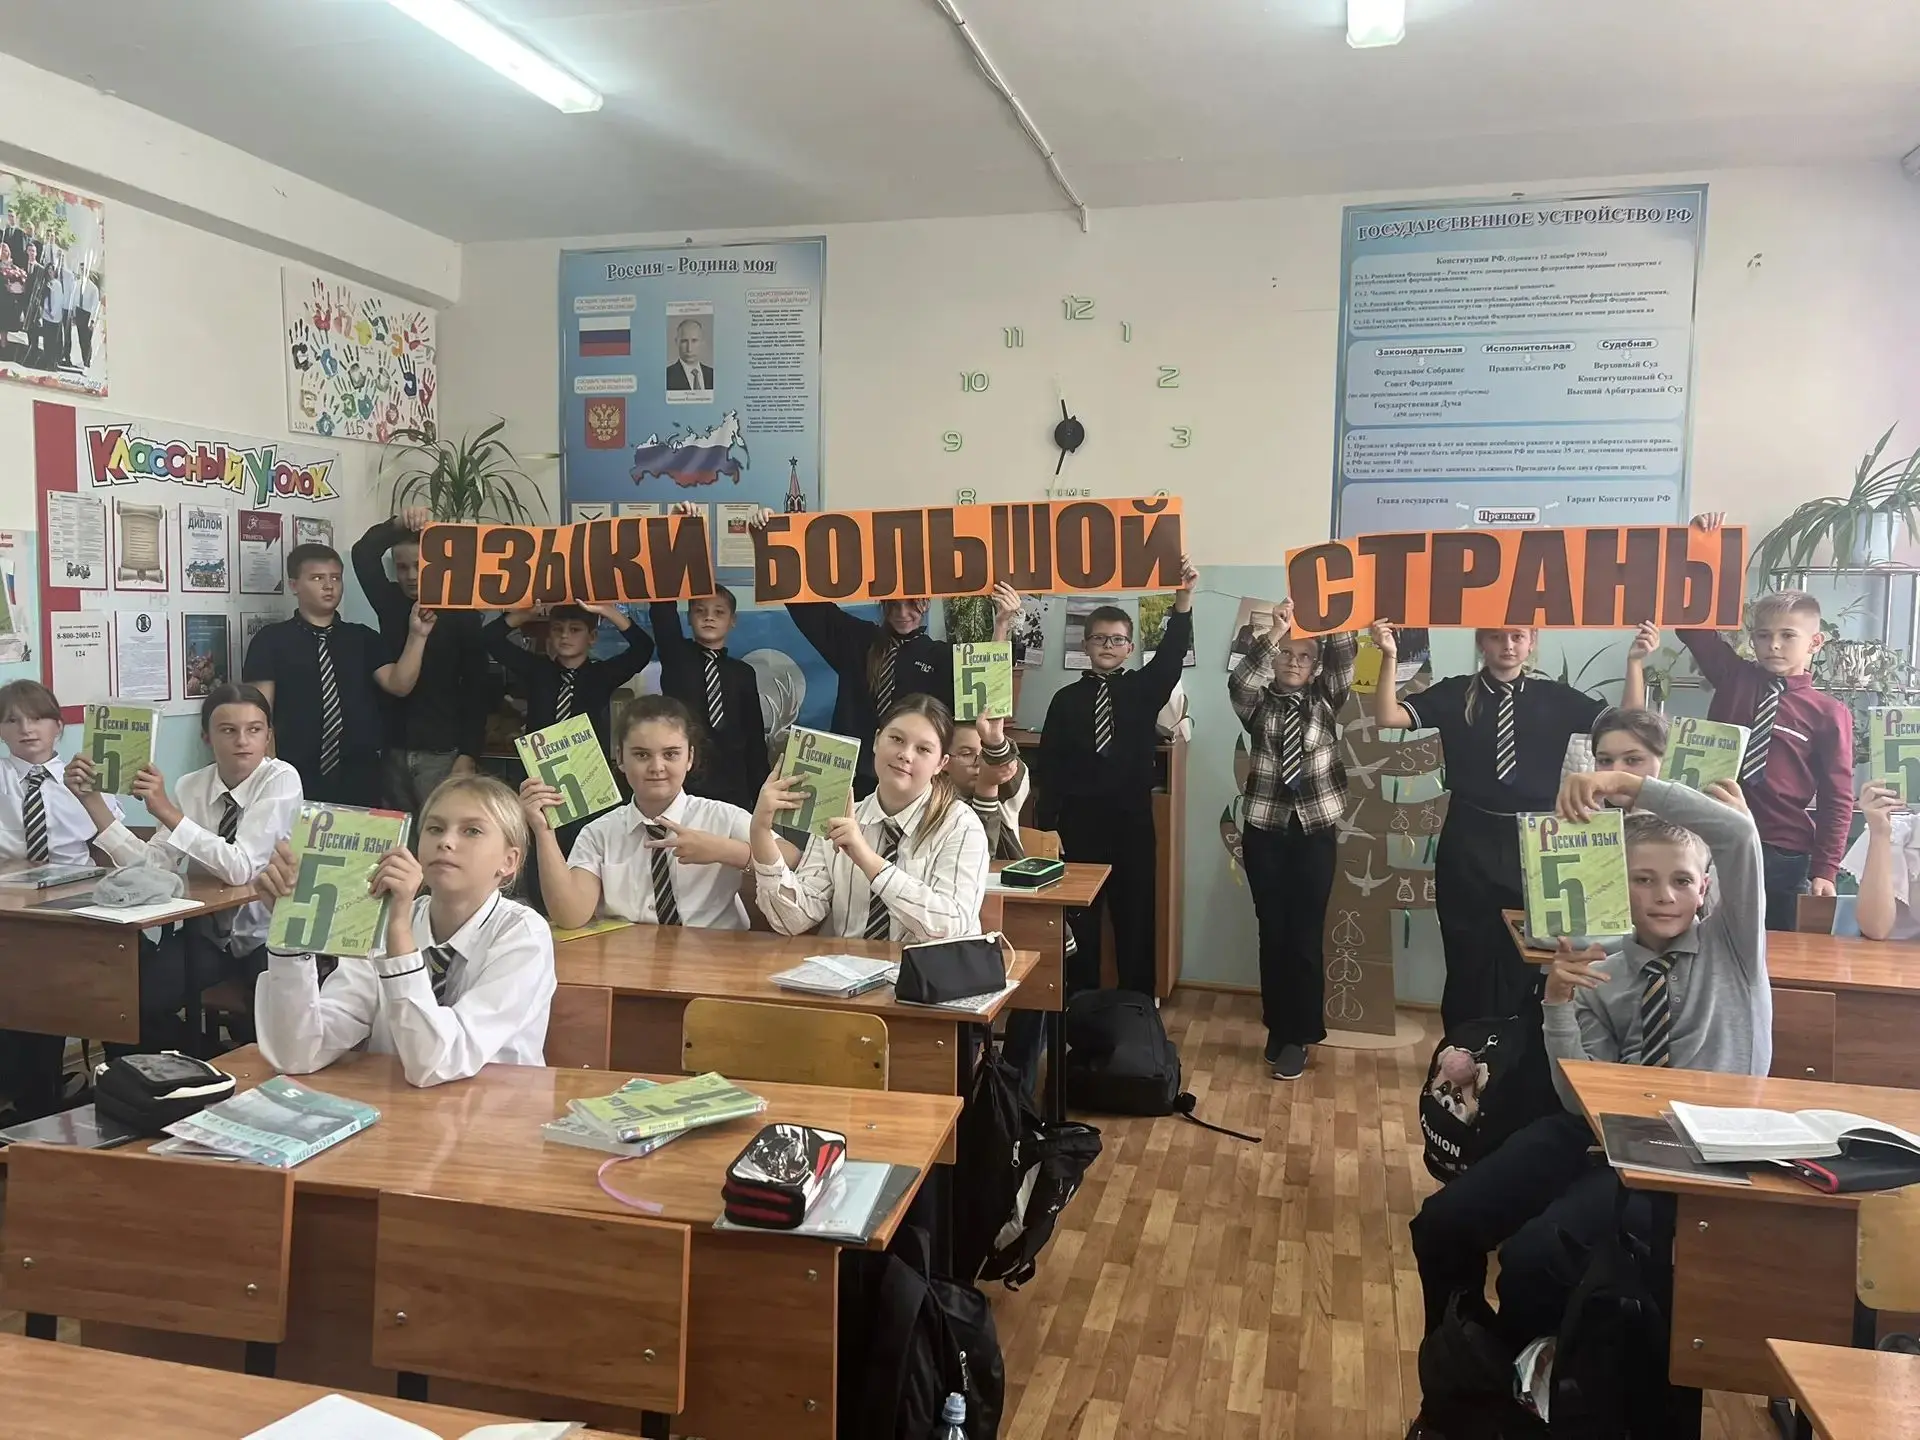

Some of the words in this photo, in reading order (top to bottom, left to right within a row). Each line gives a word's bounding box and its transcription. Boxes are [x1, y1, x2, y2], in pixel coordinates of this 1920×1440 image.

[1357, 211, 1533, 240] ГОСУДАРСТВЕННОЕ
[1537, 205, 1661, 226] УСТРОЙСТВО
[1665, 206, 1693, 223] РФ
[607, 261, 663, 280] Россия
[678, 256, 738, 276] Родина
[743, 259, 776, 273] моя
[1062, 296, 1095, 321] 12
[1003, 326, 1024, 348] 11
[1121, 320, 1132, 343] 1
[1377, 346, 1463, 356] Законодательная
[1486, 343, 1571, 353] Исполнительная
[1602, 340, 1653, 350] Судебная
[1157, 365, 1180, 389] 2
[1593, 361, 1641, 371] Верховный
[1642, 360, 1658, 369] Суд
[960, 371, 989, 392] 10
[1578, 373, 1655, 384] Конституционный
[1657, 372, 1673, 382] Суд
[1567, 387, 1602, 396] Высший
[1604, 385, 1665, 396] Арбитражный
[1667, 385, 1683, 395] Суд
[943, 430, 963, 452] 9
[1170, 426, 1191, 449] 3
[957, 487, 976, 505] 8
[187, 516, 223, 531] ДИПЛОМ
[1478, 509, 1536, 522] Президент
[420, 516, 714, 606] ЯЗЫКИ
[748, 500, 1182, 600] БОЛЬШОЙ
[1288, 527, 1742, 632] СТРАНЫ
[56, 631, 101, 640] 8-800-2000-122
[75, 650, 86, 658] 124
[961, 643, 990, 666] Русский
[992, 652, 1009, 663] язык
[961, 666, 988, 720] 5
[93, 705, 129, 732] Русский
[131, 720, 150, 732] язык
[1675, 718, 1716, 747] Русский
[530, 732, 570, 762] Русский
[572, 728, 593, 746] язык
[796, 733, 833, 763] Русский
[833, 755, 853, 771] язык
[92, 732, 122, 795] 5
[1668, 746, 1706, 791] 5
[1884, 739, 1920, 804] 5
[537, 753, 590, 824] 5
[781, 761, 823, 832] 5
[304, 810, 361, 852] Русский
[362, 836, 393, 854] язык
[1538, 816, 1588, 853] Русский
[1592, 831, 1619, 847] язык
[284, 852, 347, 952] 5
[1540, 853, 1587, 938] 5
